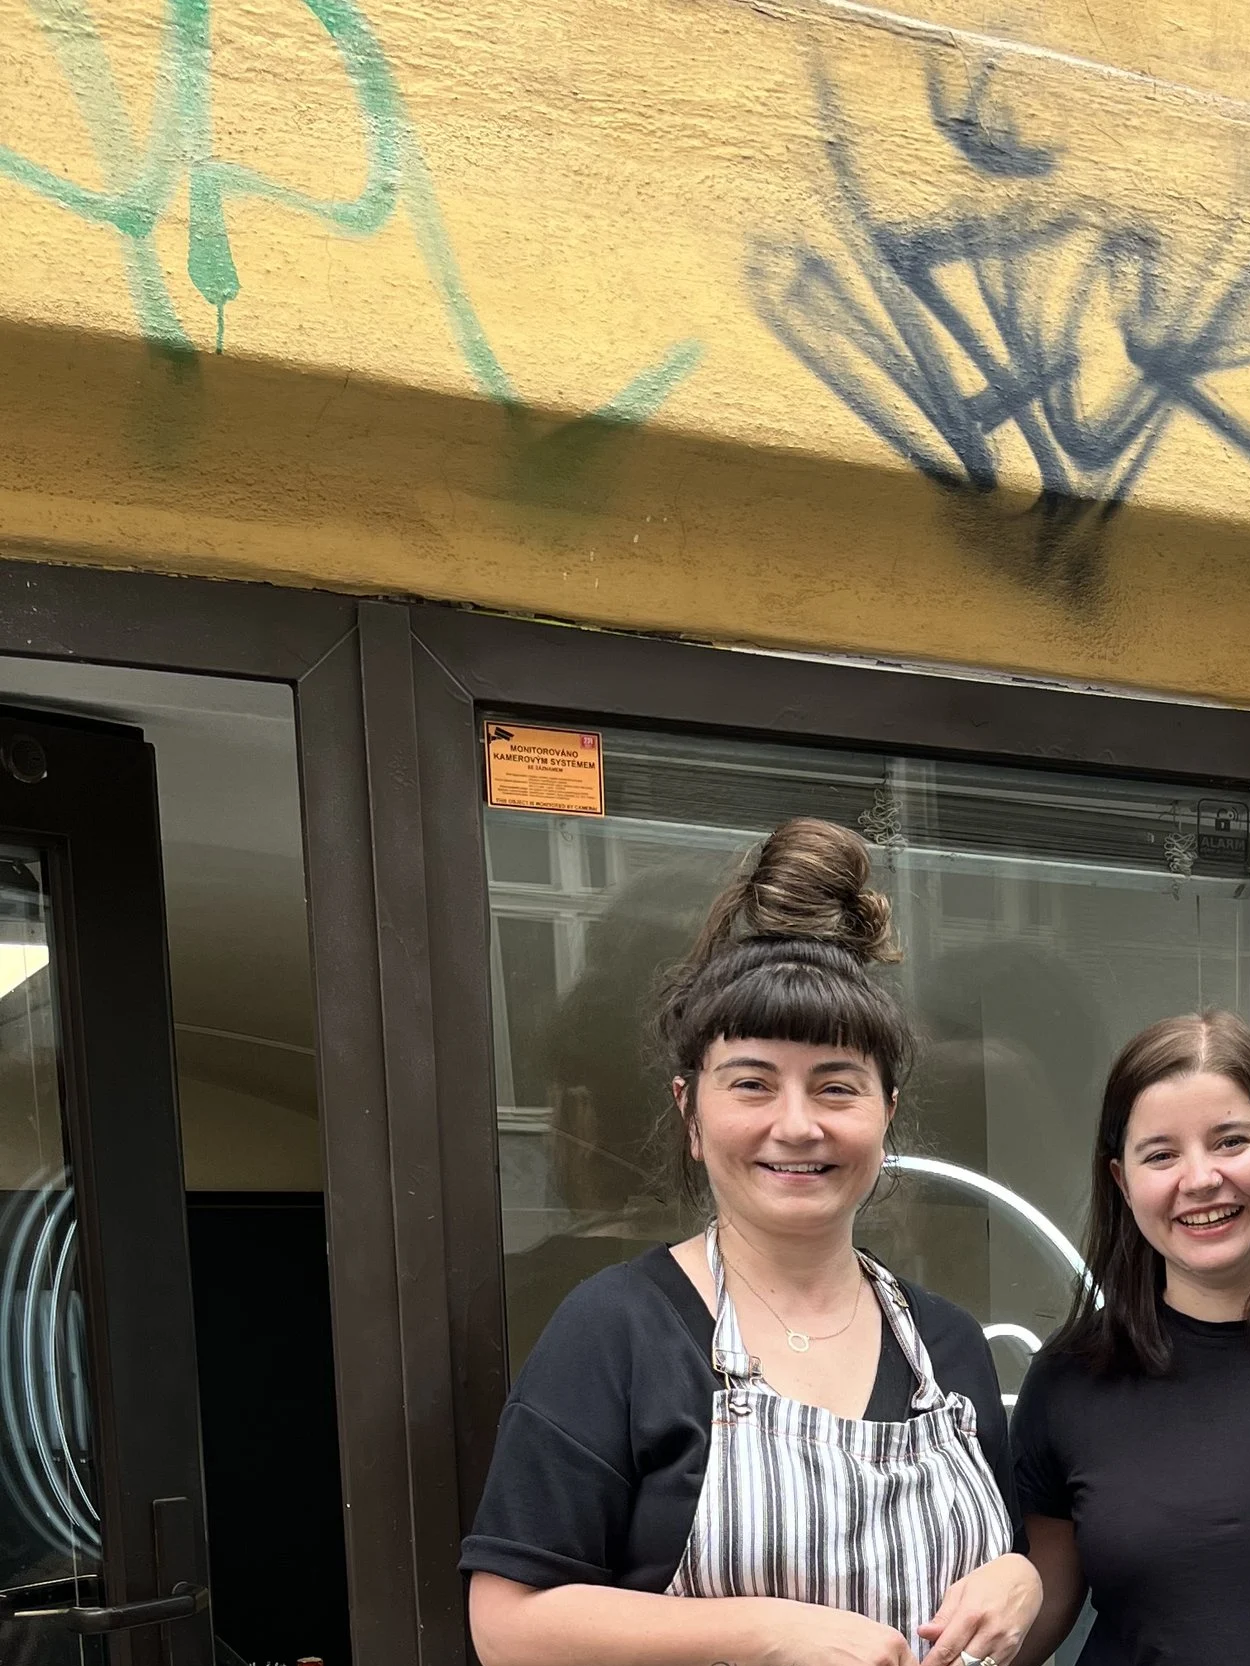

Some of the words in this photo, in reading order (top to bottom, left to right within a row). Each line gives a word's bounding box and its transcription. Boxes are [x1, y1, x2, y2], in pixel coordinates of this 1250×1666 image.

[510, 745, 579, 758] MONITOROVÁNO
[493, 753, 548, 764] KAMEROVÝM
[550, 758, 595, 769] SYSTÉMEM
[1201, 837, 1246, 851] ALARM
